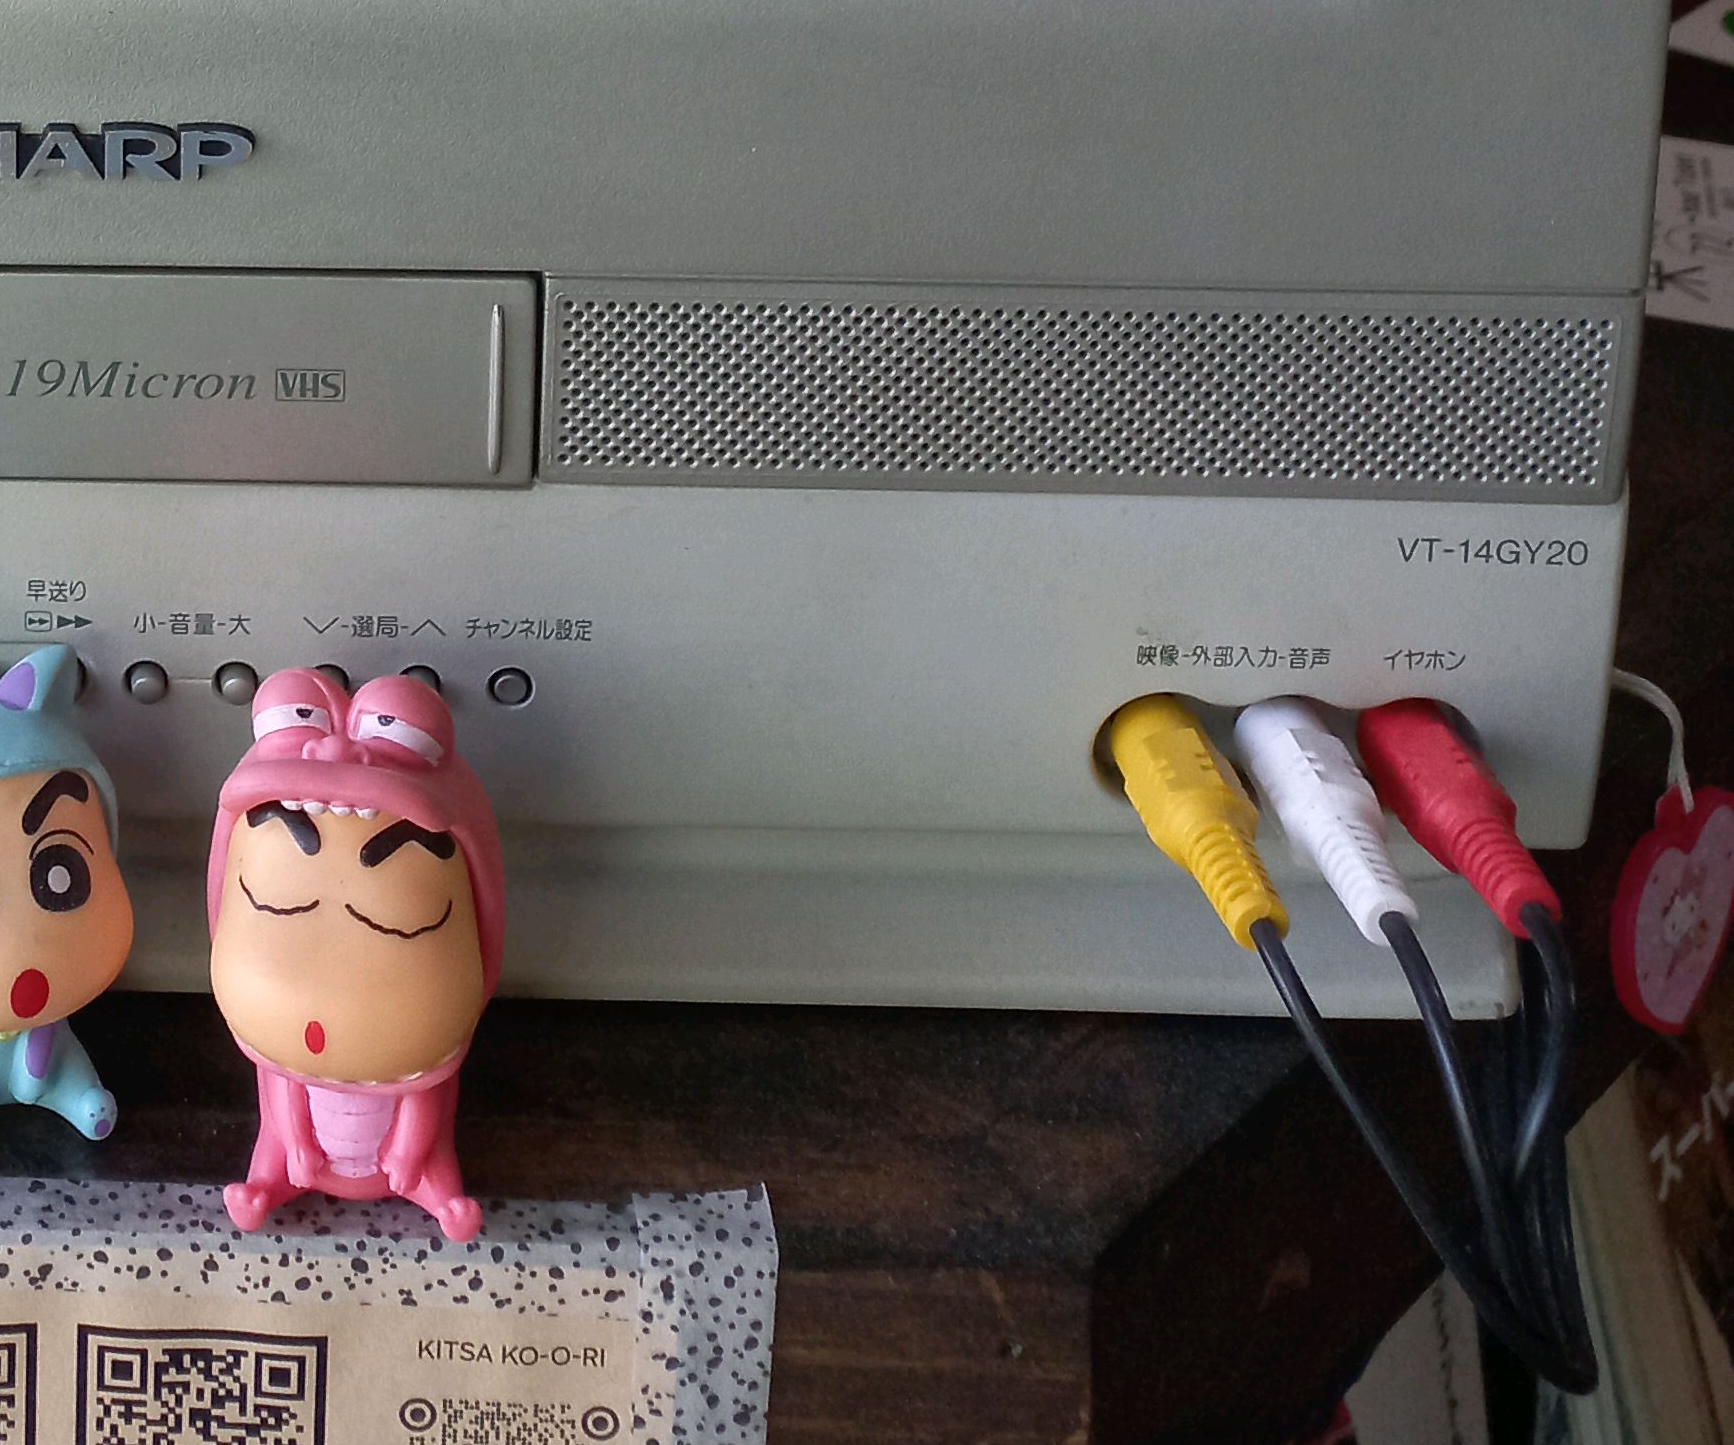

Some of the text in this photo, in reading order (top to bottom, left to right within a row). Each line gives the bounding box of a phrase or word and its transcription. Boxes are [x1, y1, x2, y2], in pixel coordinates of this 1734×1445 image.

[7, 358, 258, 401] 19Micron
[278, 371, 344, 400] VHS
[1397, 537, 1590, 567] VT-14GY20
[25, 578, 88, 602] 早送り
[465, 618, 594, 642] チャンネル設定
[1382, 648, 1467, 671] イヤホン
[417, 1339, 606, 1368] KITSA KO-O-RI
